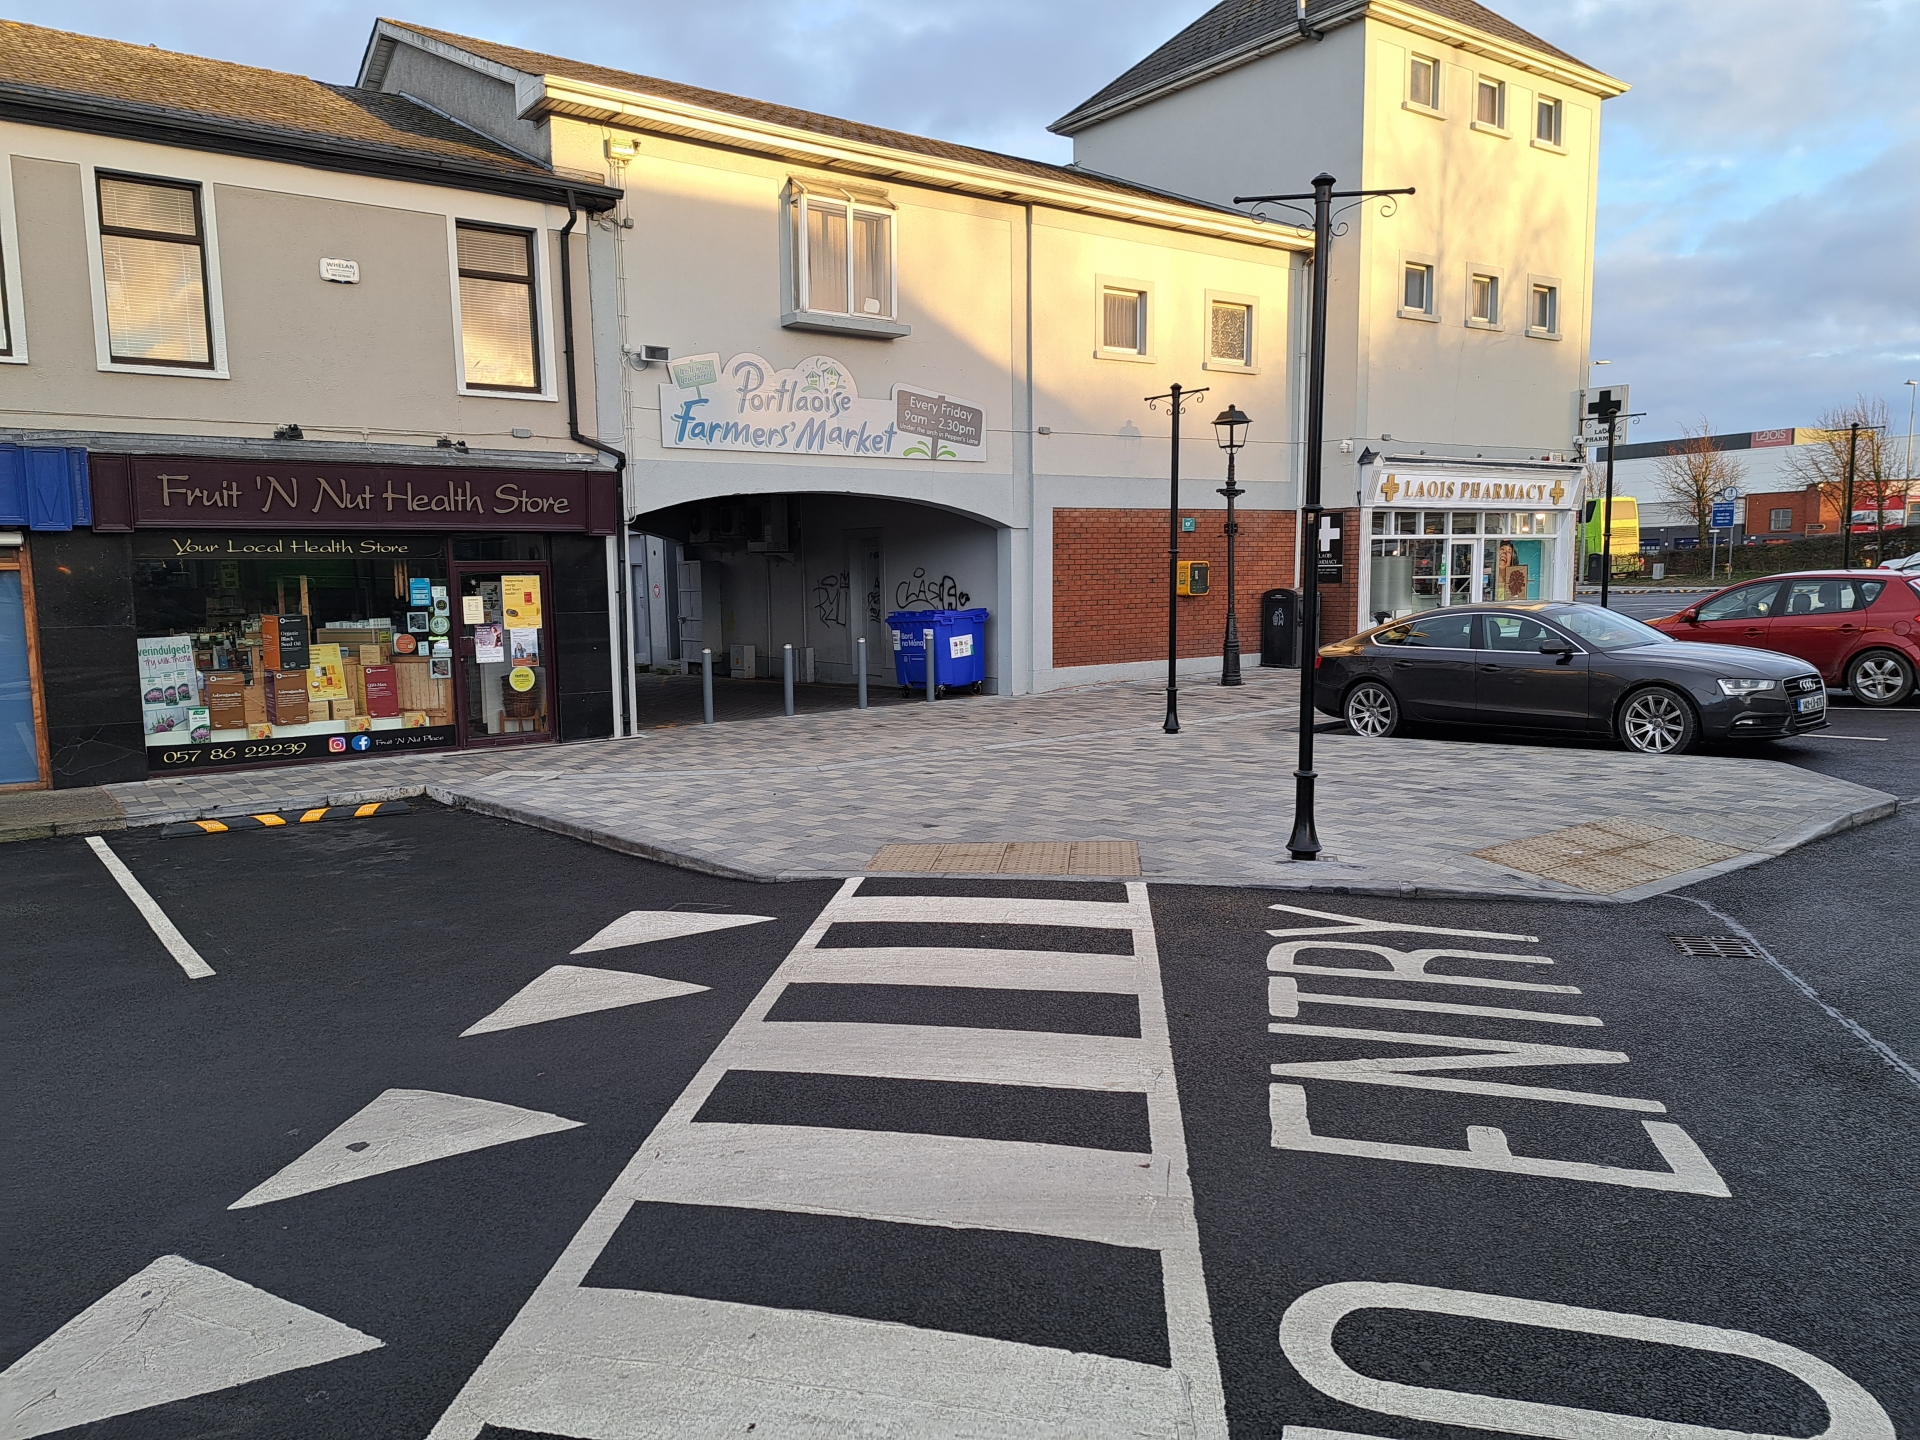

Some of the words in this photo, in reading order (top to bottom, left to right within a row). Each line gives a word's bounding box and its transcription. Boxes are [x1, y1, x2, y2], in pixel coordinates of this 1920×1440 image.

[732, 361, 852, 419] Portlaoise
[910, 396, 938, 415] Every
[941, 403, 973, 423] Friday
[670, 398, 796, 449] Farmers'
[793, 417, 898, 454] Market
[900, 422, 917, 431] Under
[916, 426, 926, 434] the
[944, 432, 966, 443] Pepper's
[966, 437, 979, 445] Lane
[904, 410, 928, 425] 9am
[938, 417, 976, 436] 2.30pm
[1585, 434, 1623, 443] PHARMCY
[157, 473, 243, 508] Fruit
[256, 475, 298, 513] 'N
[311, 477, 375, 513] Nut
[382, 480, 485, 514] Health
[493, 483, 571, 514] Store
[1403, 480, 1455, 498] LAOIS
[1460, 481, 1547, 500] PHARMACY
[172, 538, 220, 556] Your
[226, 539, 283, 553] Local
[290, 540, 353, 554] Health
[359, 540, 409, 554] Store
[137, 643, 190, 657] verindulged?
[163, 750, 202, 764] 057
[210, 747, 236, 760] 86
[244, 742, 307, 758] 22239
[1266, 904, 1732, 1198] ENTRY
